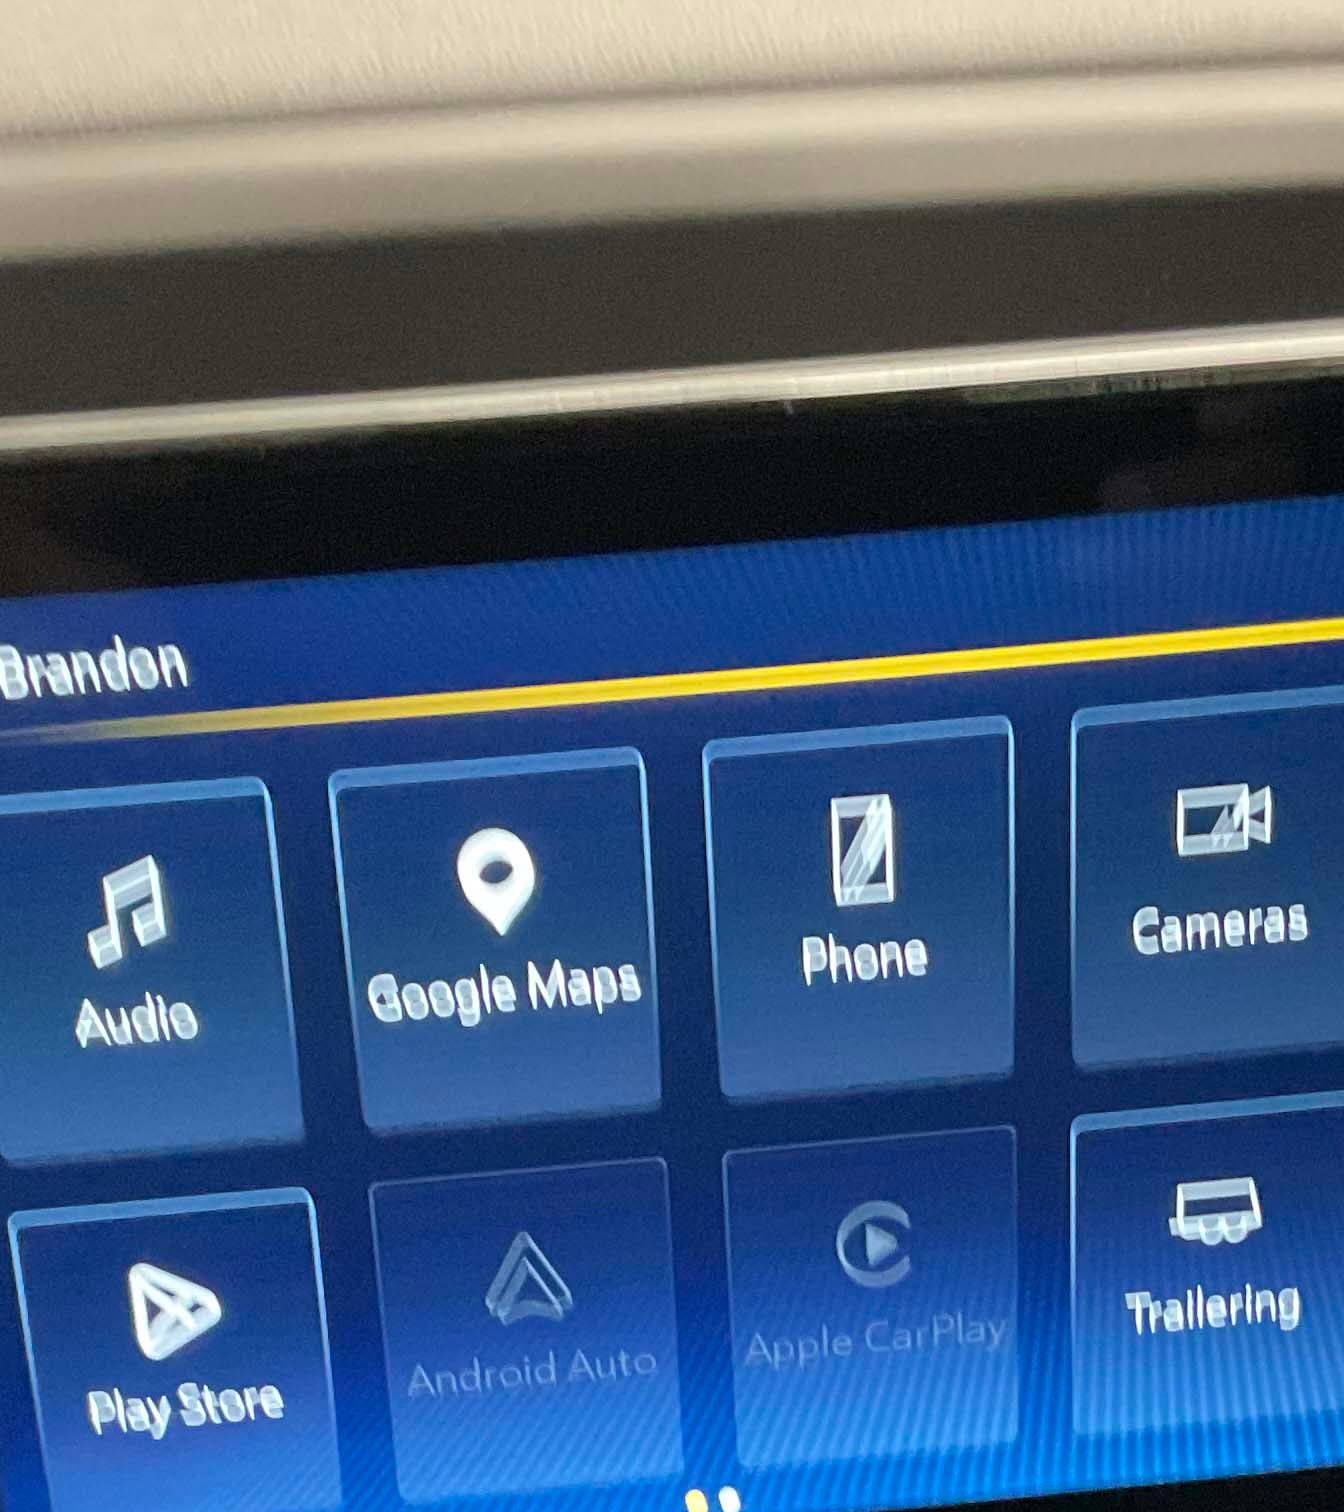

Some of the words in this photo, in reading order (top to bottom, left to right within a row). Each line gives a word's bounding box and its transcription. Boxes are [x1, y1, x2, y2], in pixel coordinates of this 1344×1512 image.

[1131, 898, 1310, 957] Cameras
[800, 933, 929, 988] Phone
[74, 991, 201, 1049] Audio
[368, 963, 517, 1028] Google
[527, 957, 643, 1015] Maps
[1125, 1283, 1301, 1334] Trailering
[746, 1332, 854, 1369] Apple
[864, 1316, 1007, 1358] CarPlay
[407, 1357, 559, 1400] Android
[568, 1348, 659, 1384] Auto
[86, 1389, 173, 1441] Play
[179, 1378, 285, 1428] Store
